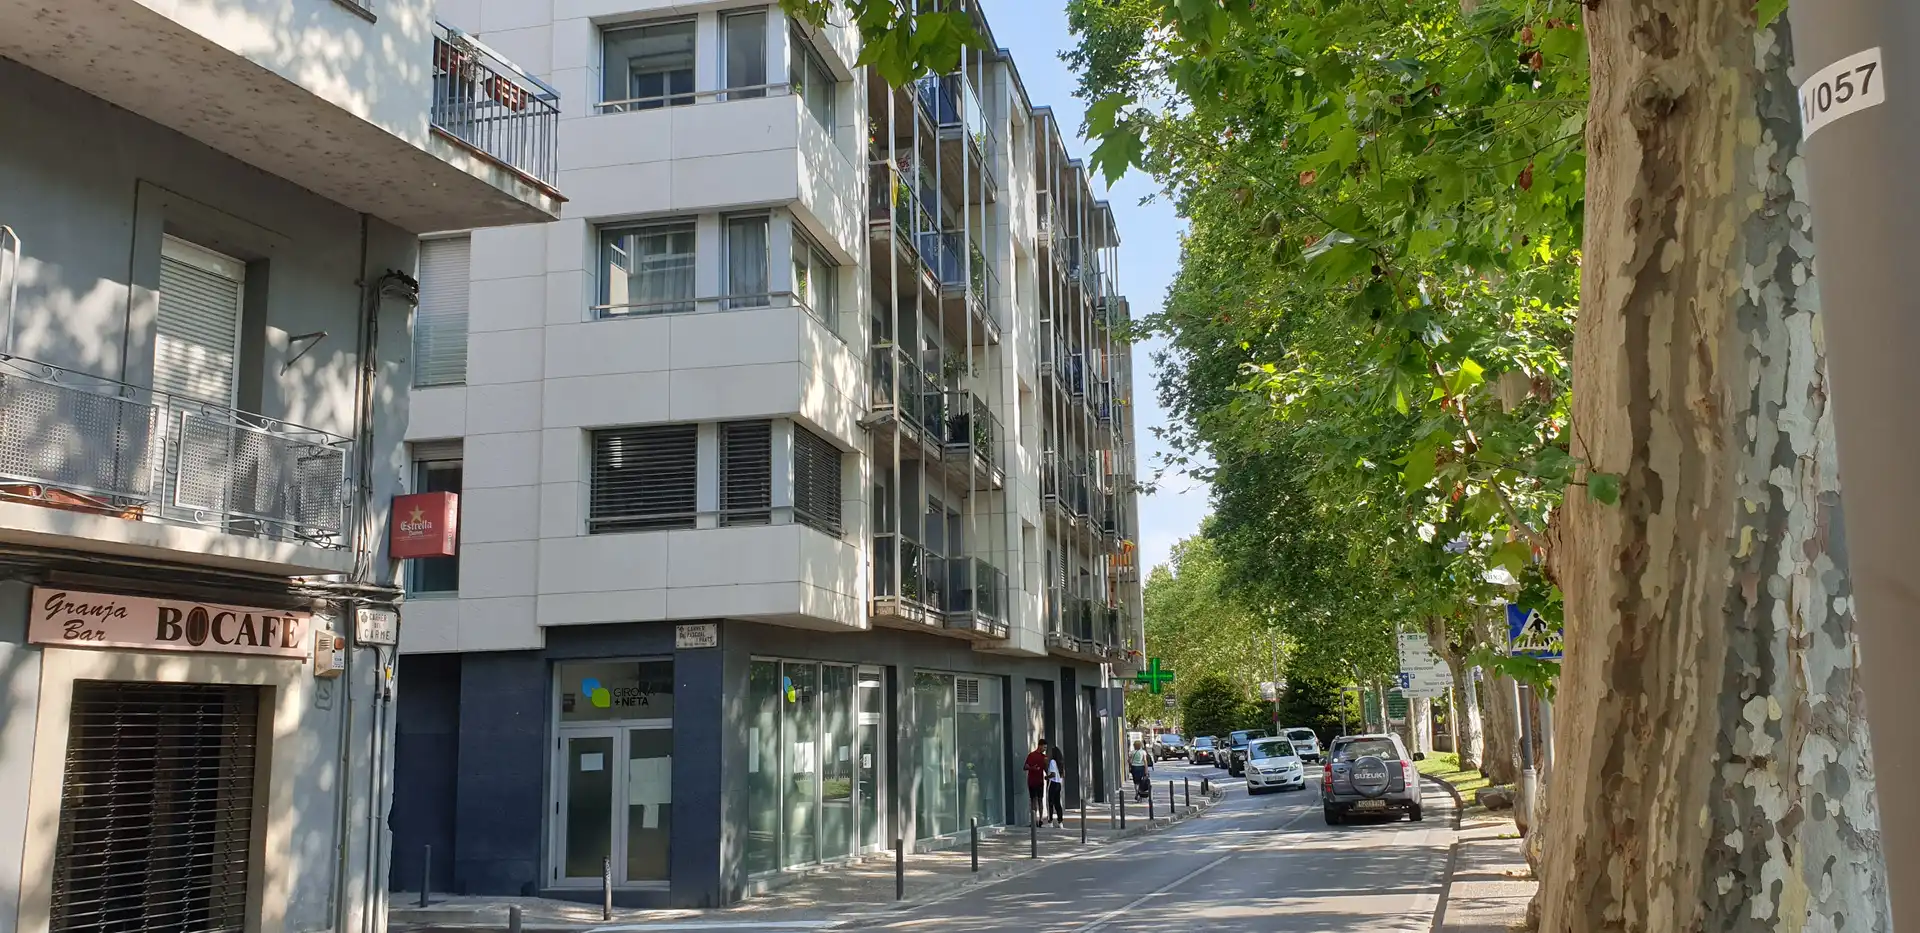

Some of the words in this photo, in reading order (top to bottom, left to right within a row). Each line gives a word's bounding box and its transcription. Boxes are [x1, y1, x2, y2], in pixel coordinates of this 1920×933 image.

[400, 517, 432, 531] Estrella
[44, 592, 128, 623] Granja
[369, 613, 388, 622] CARRER
[63, 619, 106, 641] Bar
[364, 629, 391, 640] CARME
[613, 687, 655, 697] GIRONA
[1353, 772, 1386, 780] SUZUKI
